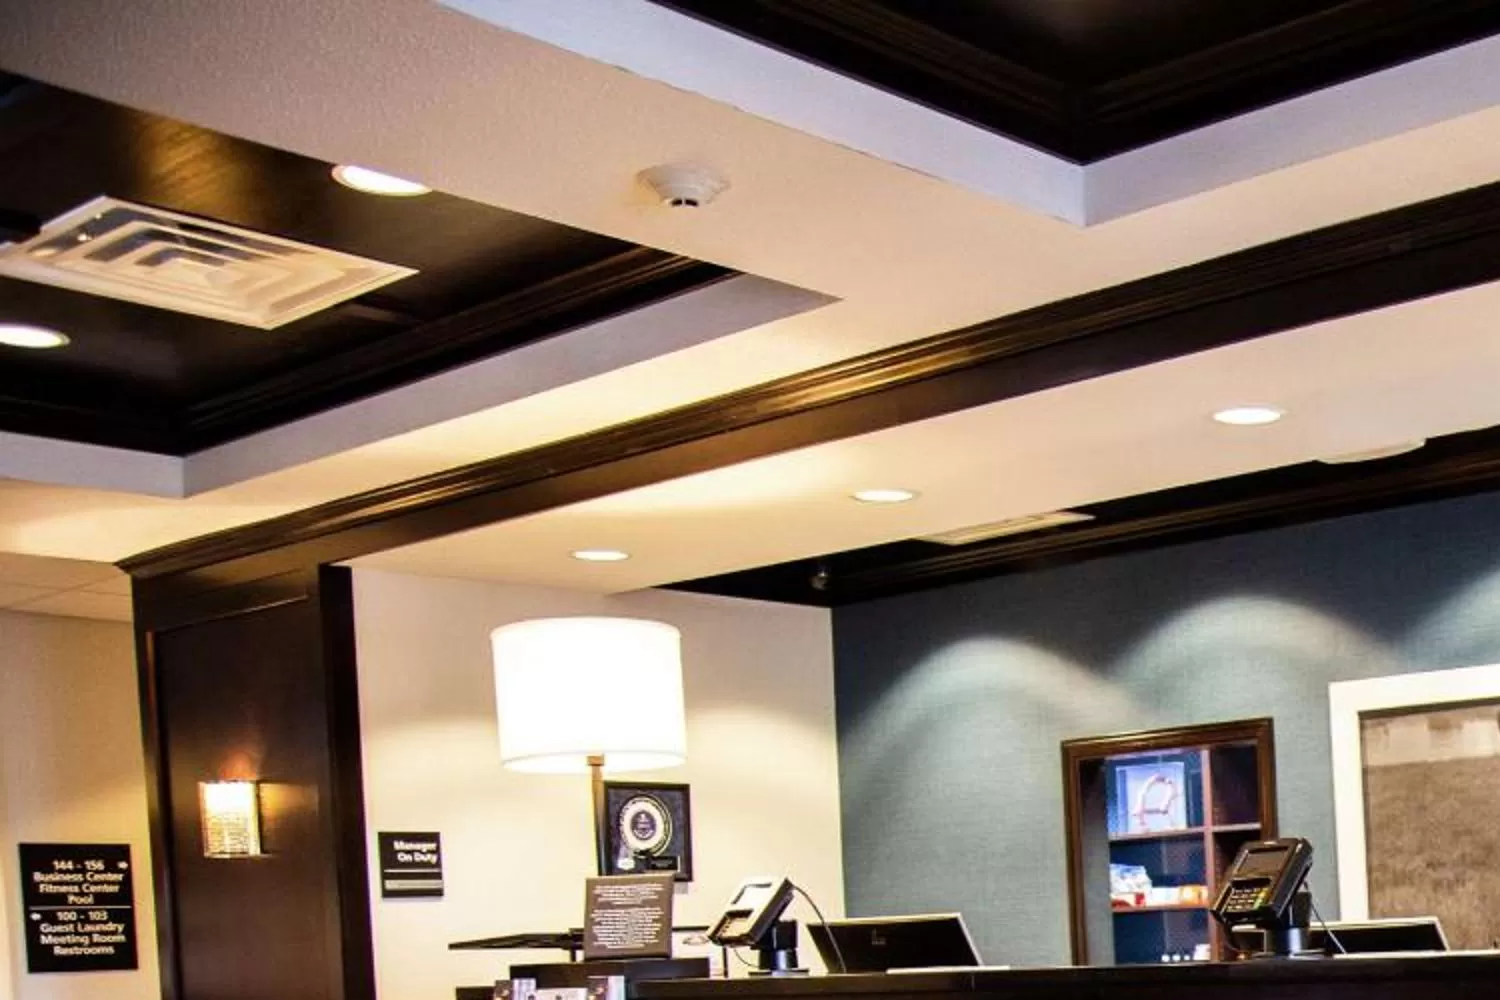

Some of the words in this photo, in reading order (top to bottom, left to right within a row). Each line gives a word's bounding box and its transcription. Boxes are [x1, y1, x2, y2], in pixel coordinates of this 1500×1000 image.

[393, 840, 437, 852] Manager
[397, 852, 413, 863] On
[413, 852, 438, 864] Duty
[53, 860, 74, 870] 144
[33, 872, 84, 882] Business
[85, 871, 124, 882] Center
[39, 884, 80, 893] Fitness
[81, 883, 120, 893] Center
[67, 894, 94, 904] Pool
[56, 911, 77, 921] 100
[40, 923, 75, 933] Guest
[77, 922, 125, 933] Laundry
[40, 934, 90, 946] Meeting
[91, 933, 126, 943] Room
[53, 946, 115, 956] Restrooms
